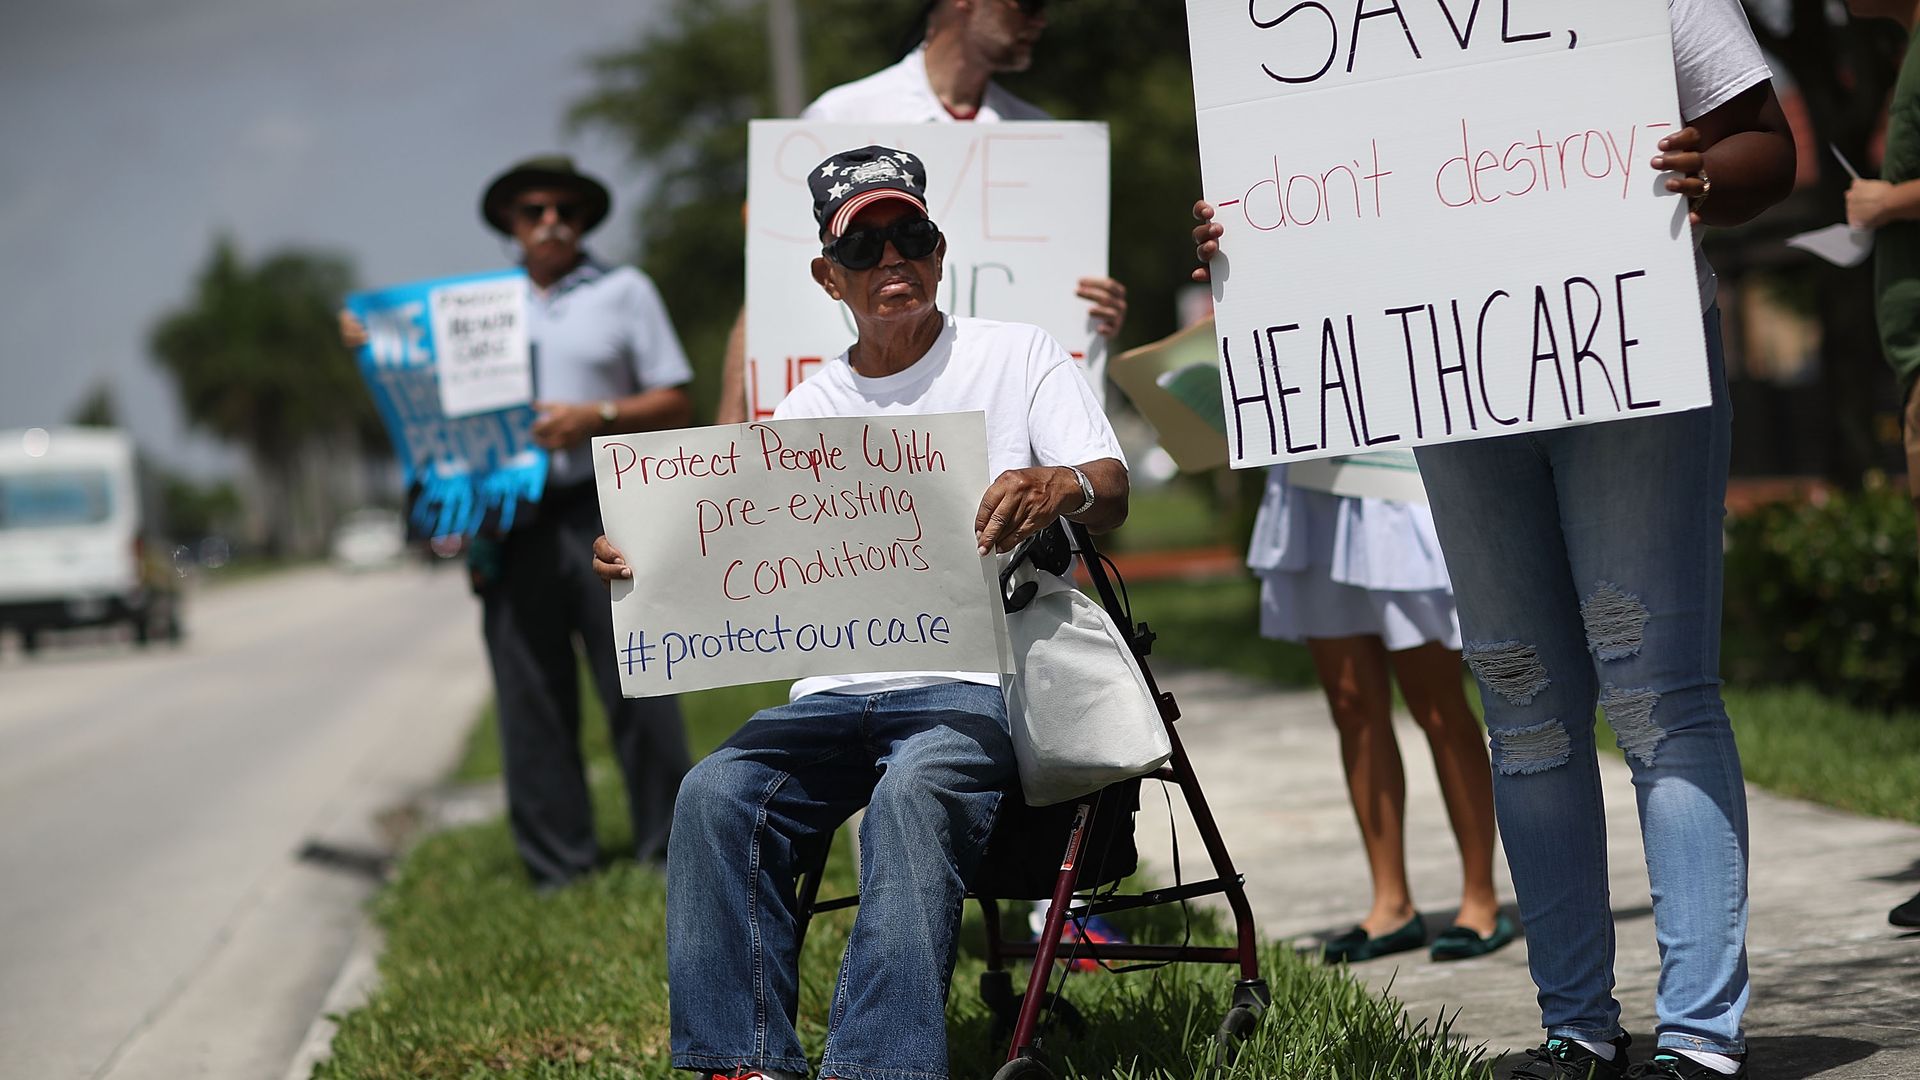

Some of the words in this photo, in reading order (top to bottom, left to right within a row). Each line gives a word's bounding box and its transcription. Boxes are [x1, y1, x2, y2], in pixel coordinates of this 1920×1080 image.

[1223, 269, 1661, 460] HEALTHCARE
[603, 441, 741, 490] Protect
[749, 423, 847, 482] People
[861, 424, 946, 475] With
[696, 480, 923, 557] pre-existing
[723, 538, 930, 601] conditions
